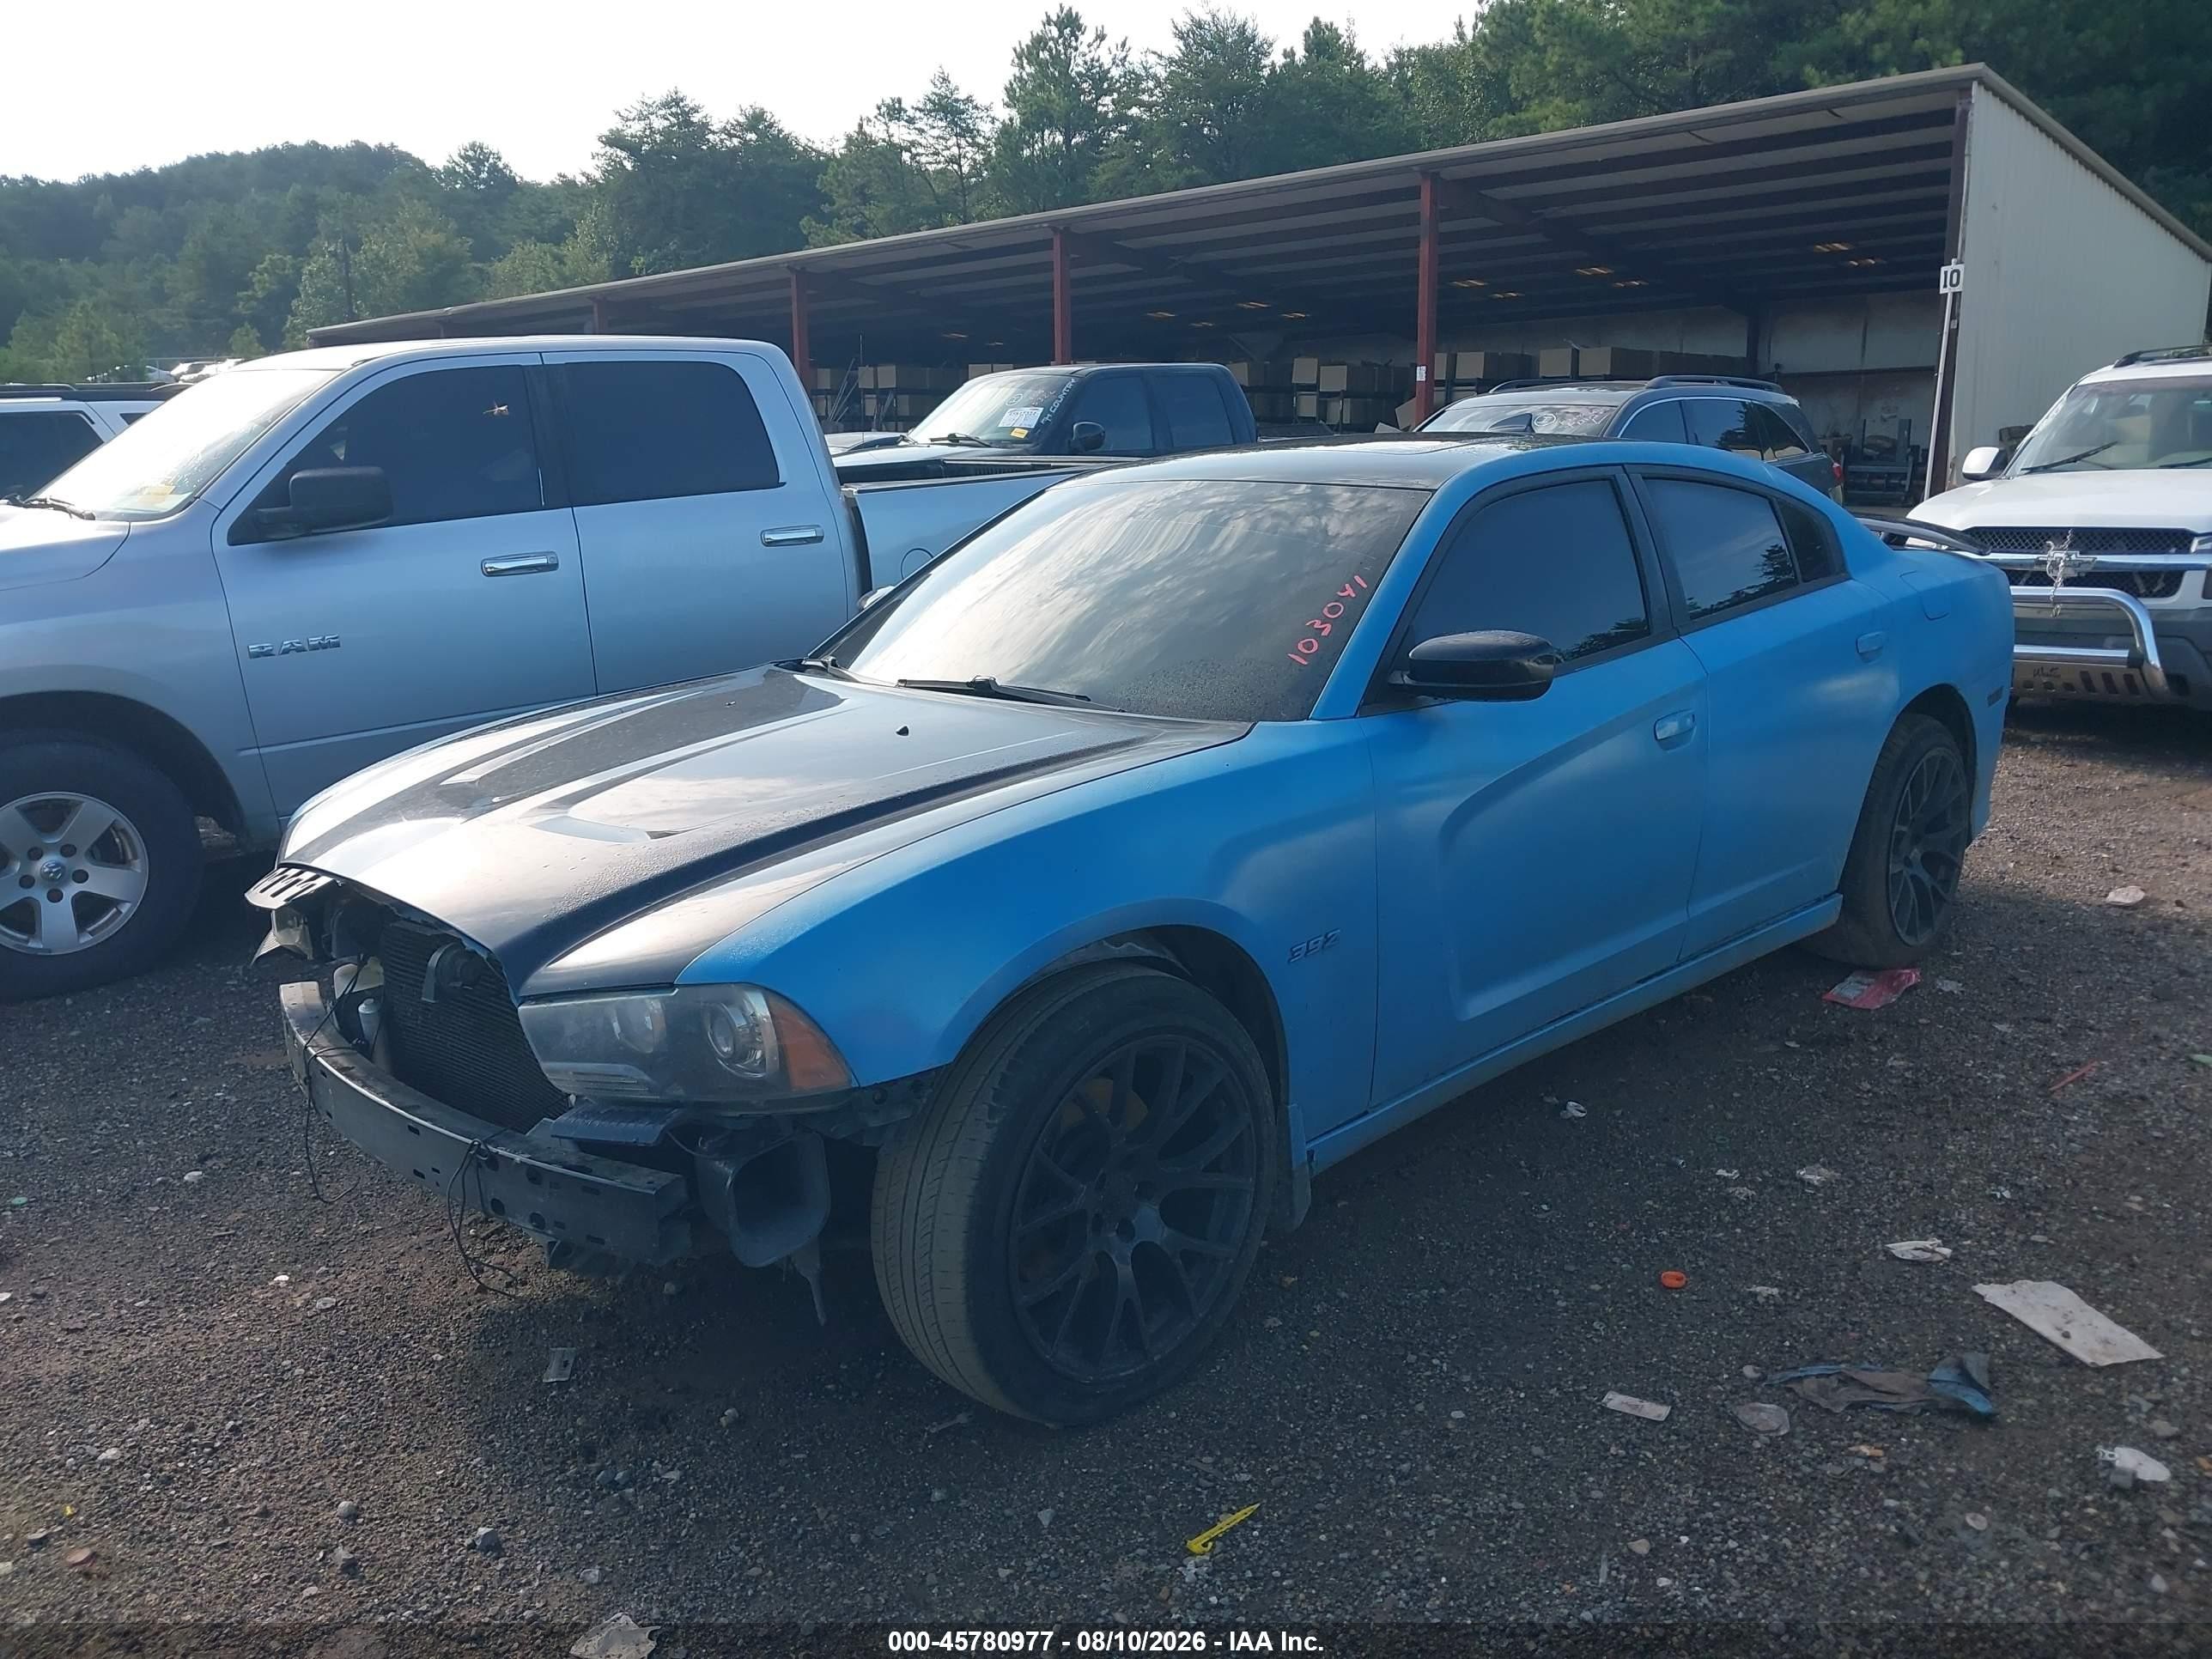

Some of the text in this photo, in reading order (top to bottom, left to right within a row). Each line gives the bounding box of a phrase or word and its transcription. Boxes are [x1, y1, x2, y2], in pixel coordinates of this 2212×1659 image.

[1942, 268, 1961, 289] 10
[1049, 378, 1077, 413] COUNTRY
[1287, 574, 1368, 665] 103041
[247, 633, 341, 659] RAM
[1287, 927, 1341, 964] 392
